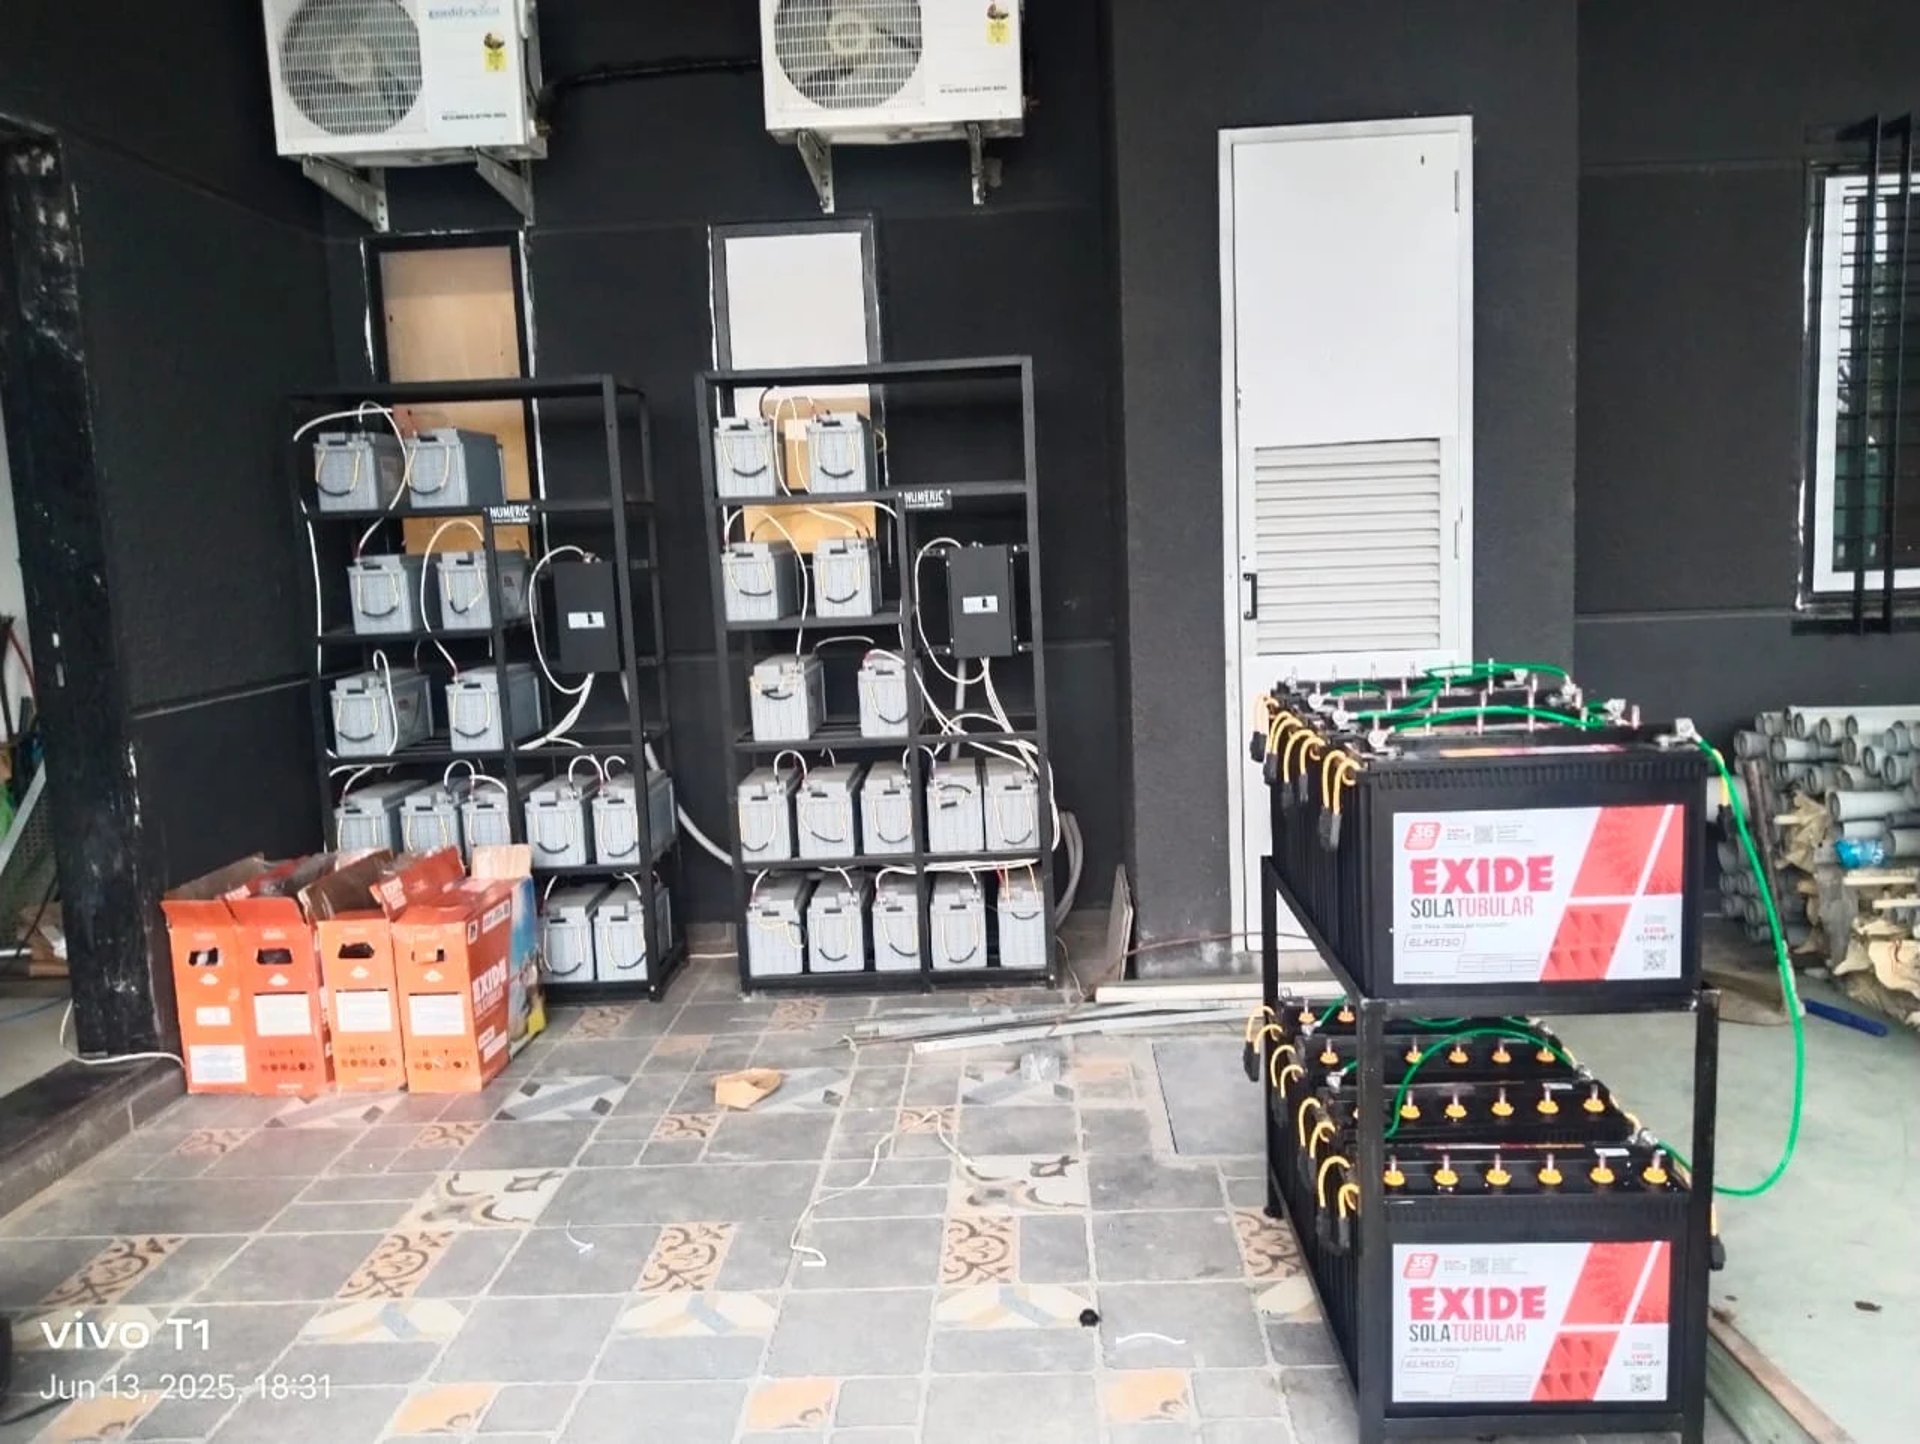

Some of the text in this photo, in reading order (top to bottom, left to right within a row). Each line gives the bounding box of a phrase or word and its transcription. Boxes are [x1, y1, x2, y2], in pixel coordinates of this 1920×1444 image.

[904, 489, 944, 503] NUMERIC
[489, 504, 530, 518] NUMERIC
[1410, 856, 1553, 895] EXIDE
[1410, 896, 1534, 919] SOLATUBULAR
[1409, 1286, 1546, 1320] EXIDE
[1409, 1324, 1526, 1343] SOLATUBULAR
